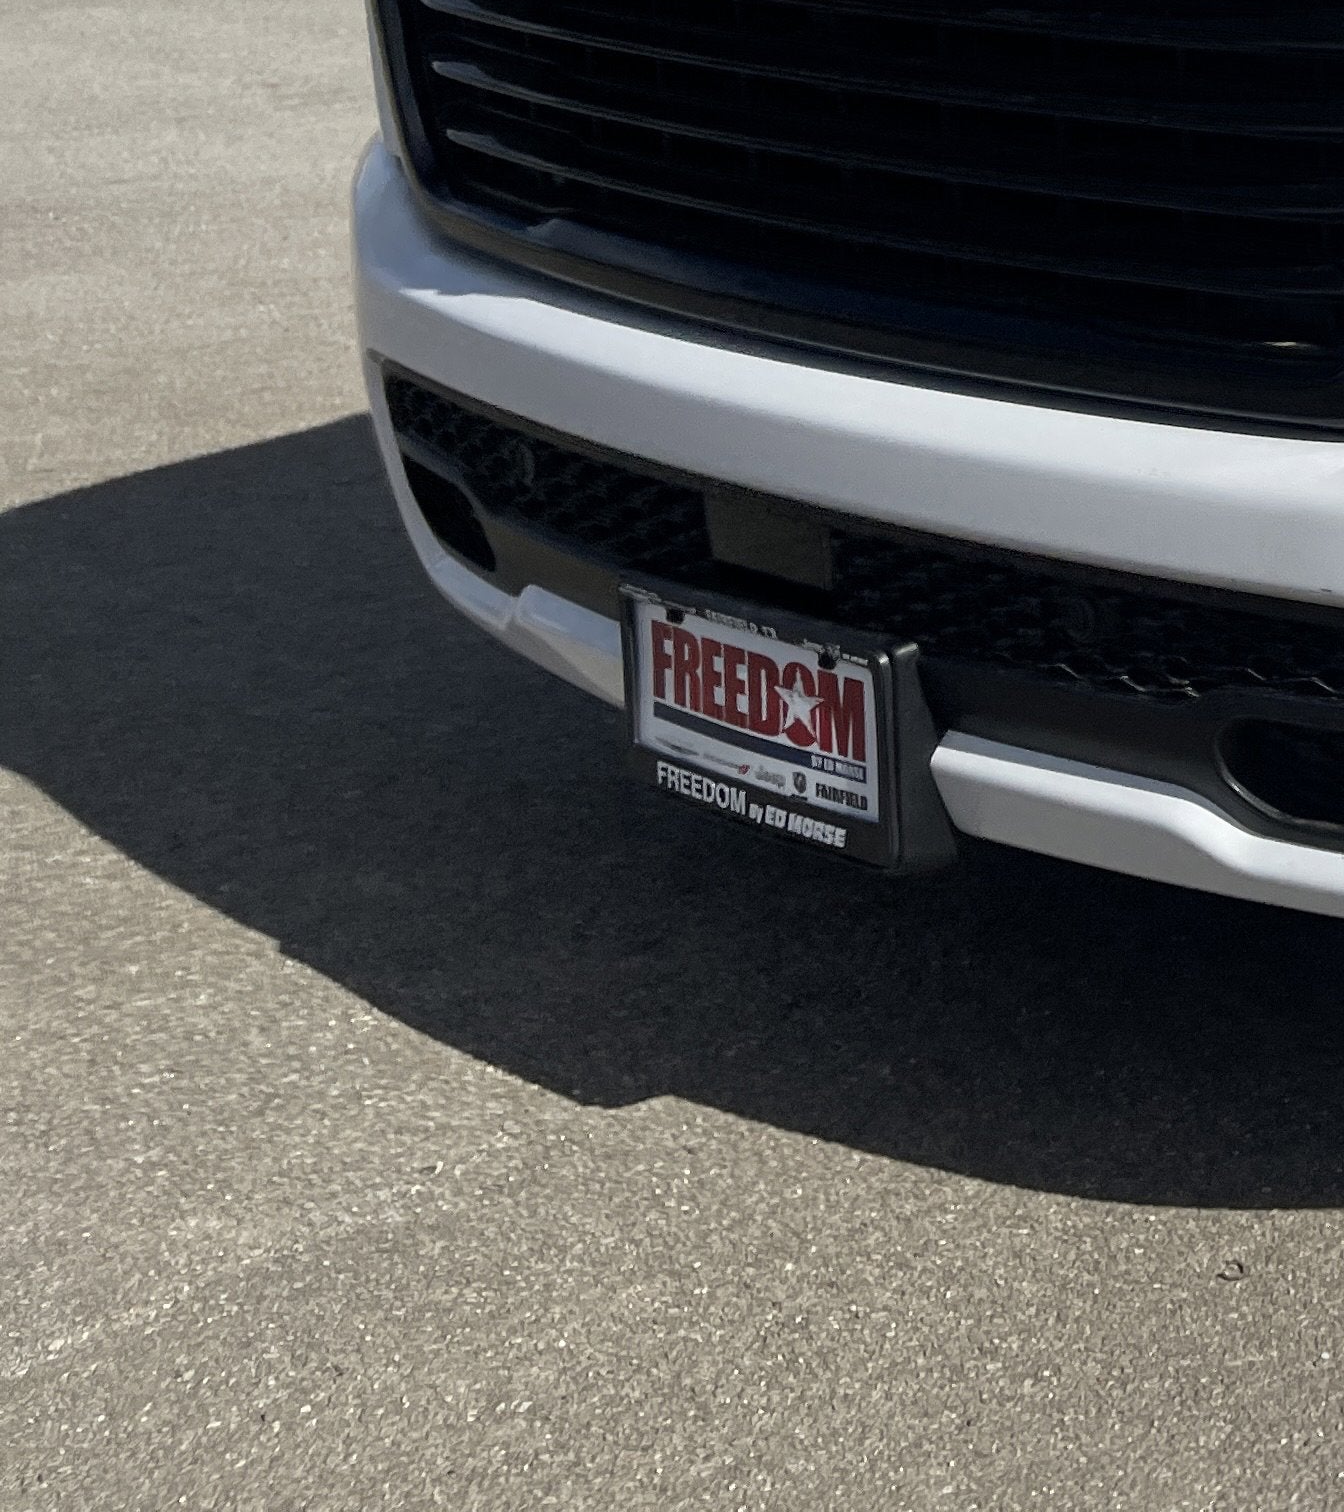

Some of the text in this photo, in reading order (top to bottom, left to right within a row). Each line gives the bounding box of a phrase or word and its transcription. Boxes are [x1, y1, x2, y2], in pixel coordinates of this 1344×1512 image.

[651, 619, 867, 763] FREEDOM
[657, 760, 747, 815] FREEDOM
[765, 804, 787, 828] ED
[787, 812, 847, 848] MORSE
[815, 782, 868, 811] FAIRFIELD
